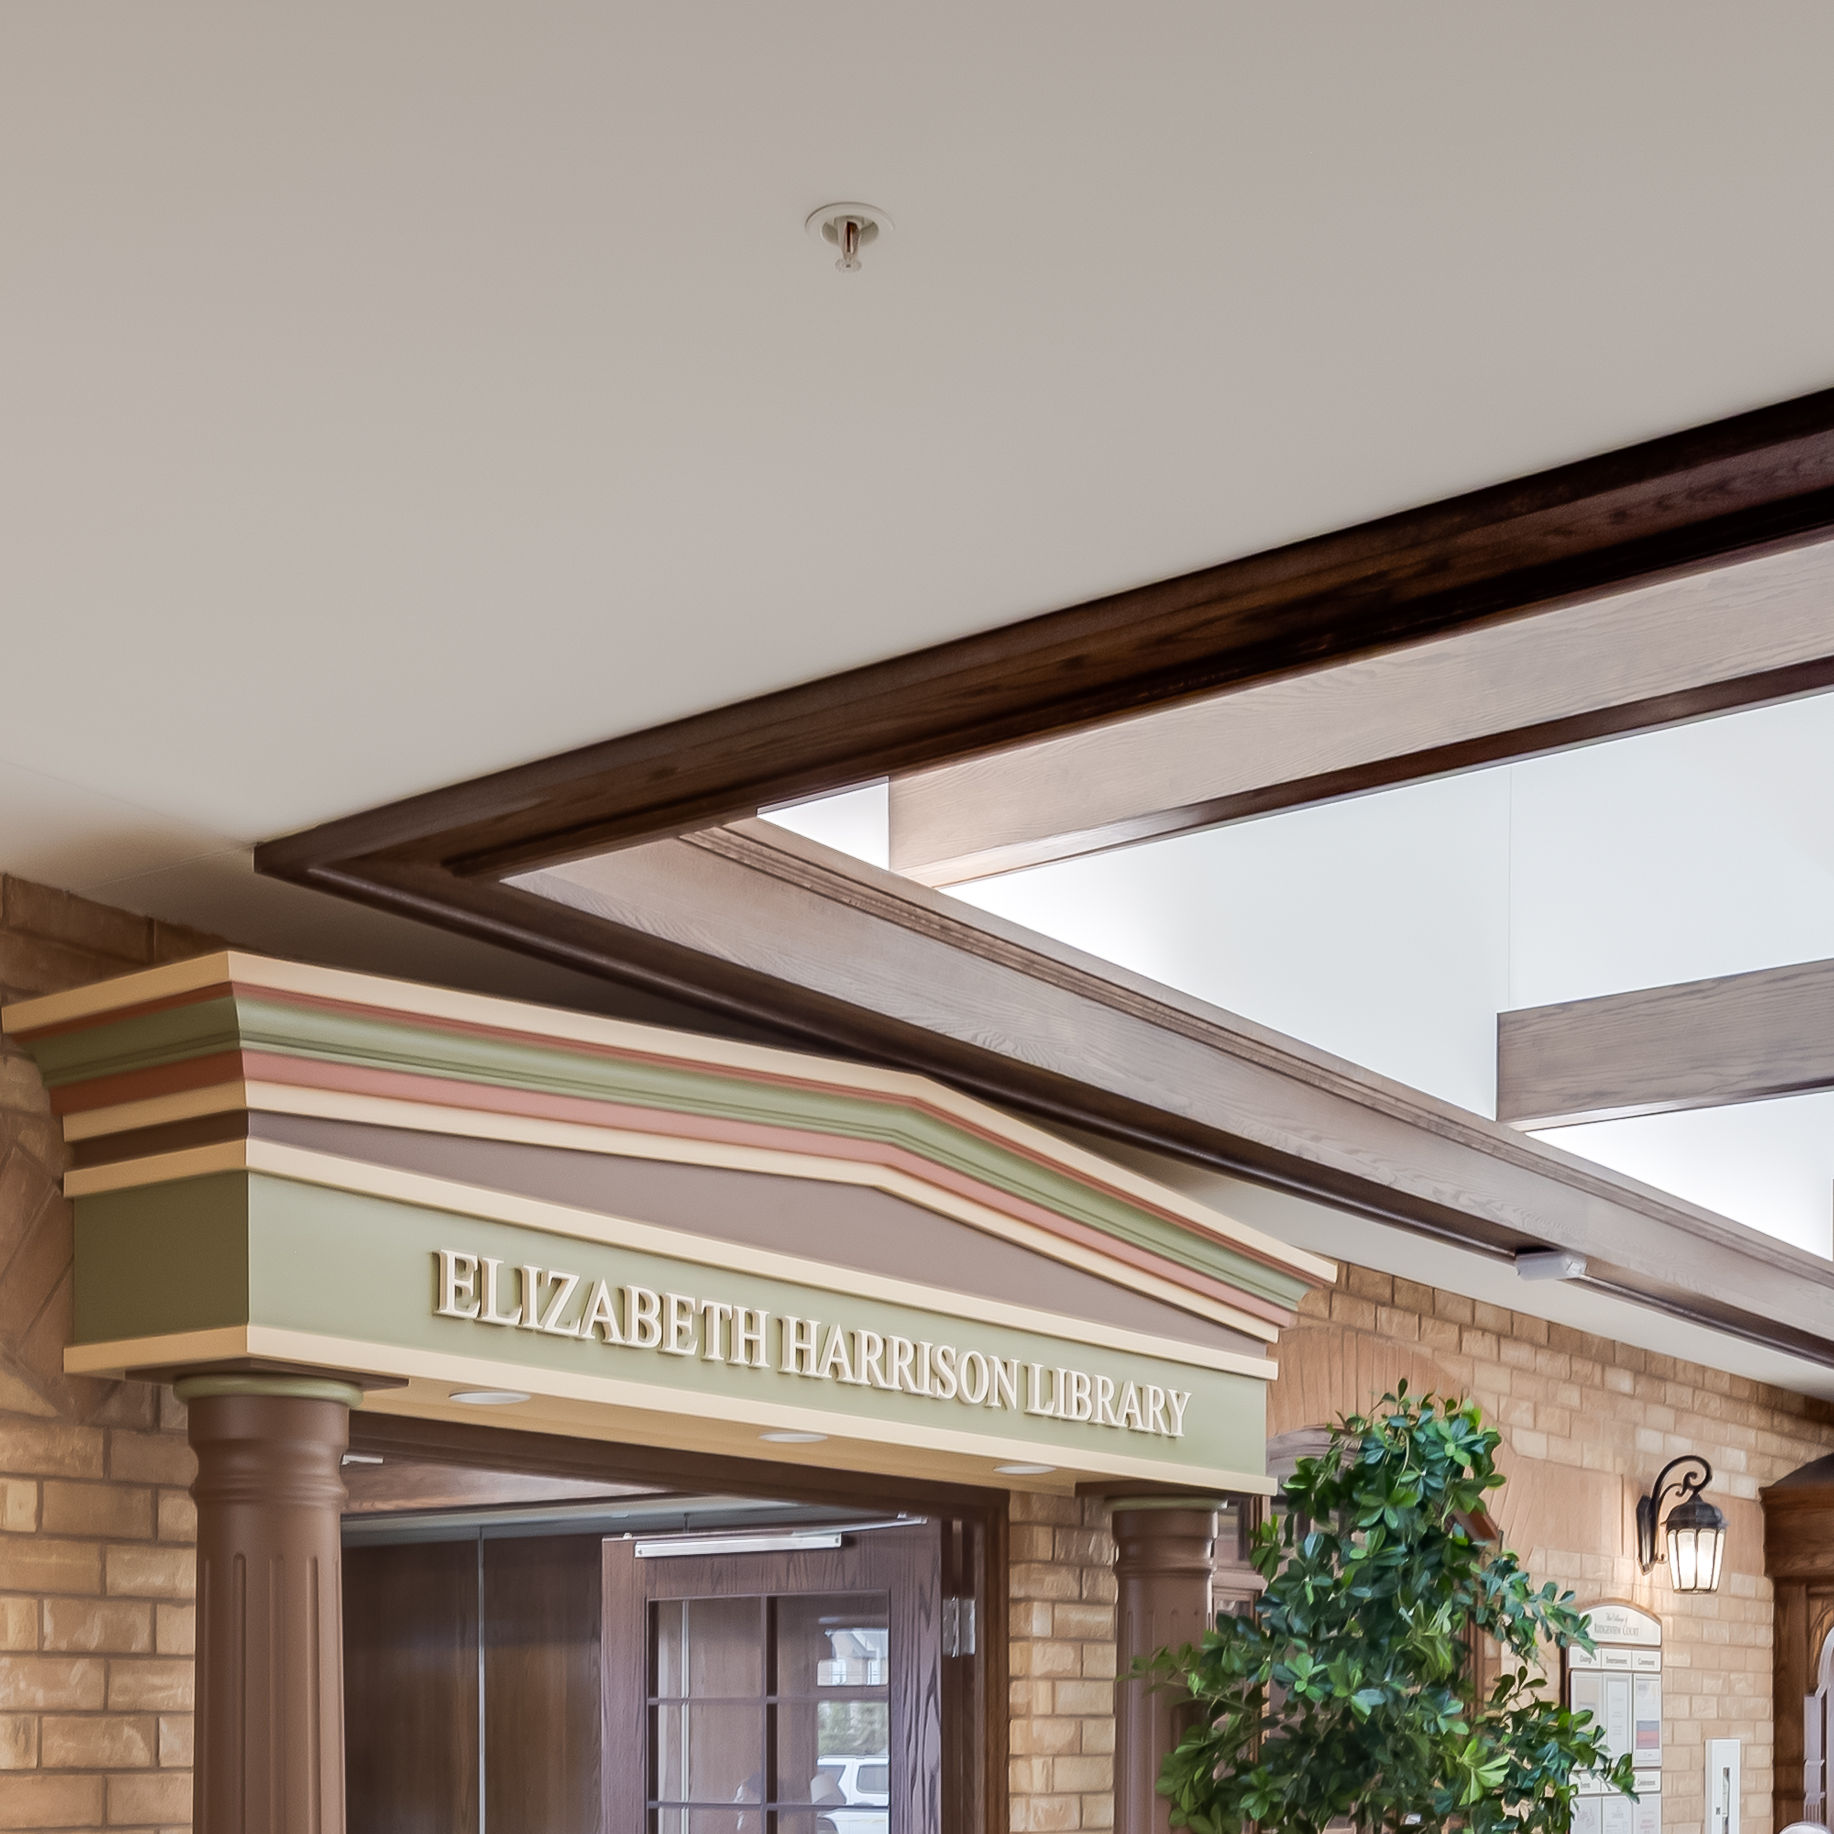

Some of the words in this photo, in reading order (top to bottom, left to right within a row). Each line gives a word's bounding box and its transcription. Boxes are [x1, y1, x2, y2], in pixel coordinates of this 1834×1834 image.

[433, 1249, 770, 1368] ELIZABETH
[778, 1314, 1022, 1412] HARRISON
[1024, 1362, 1192, 1438] LIBRARY
